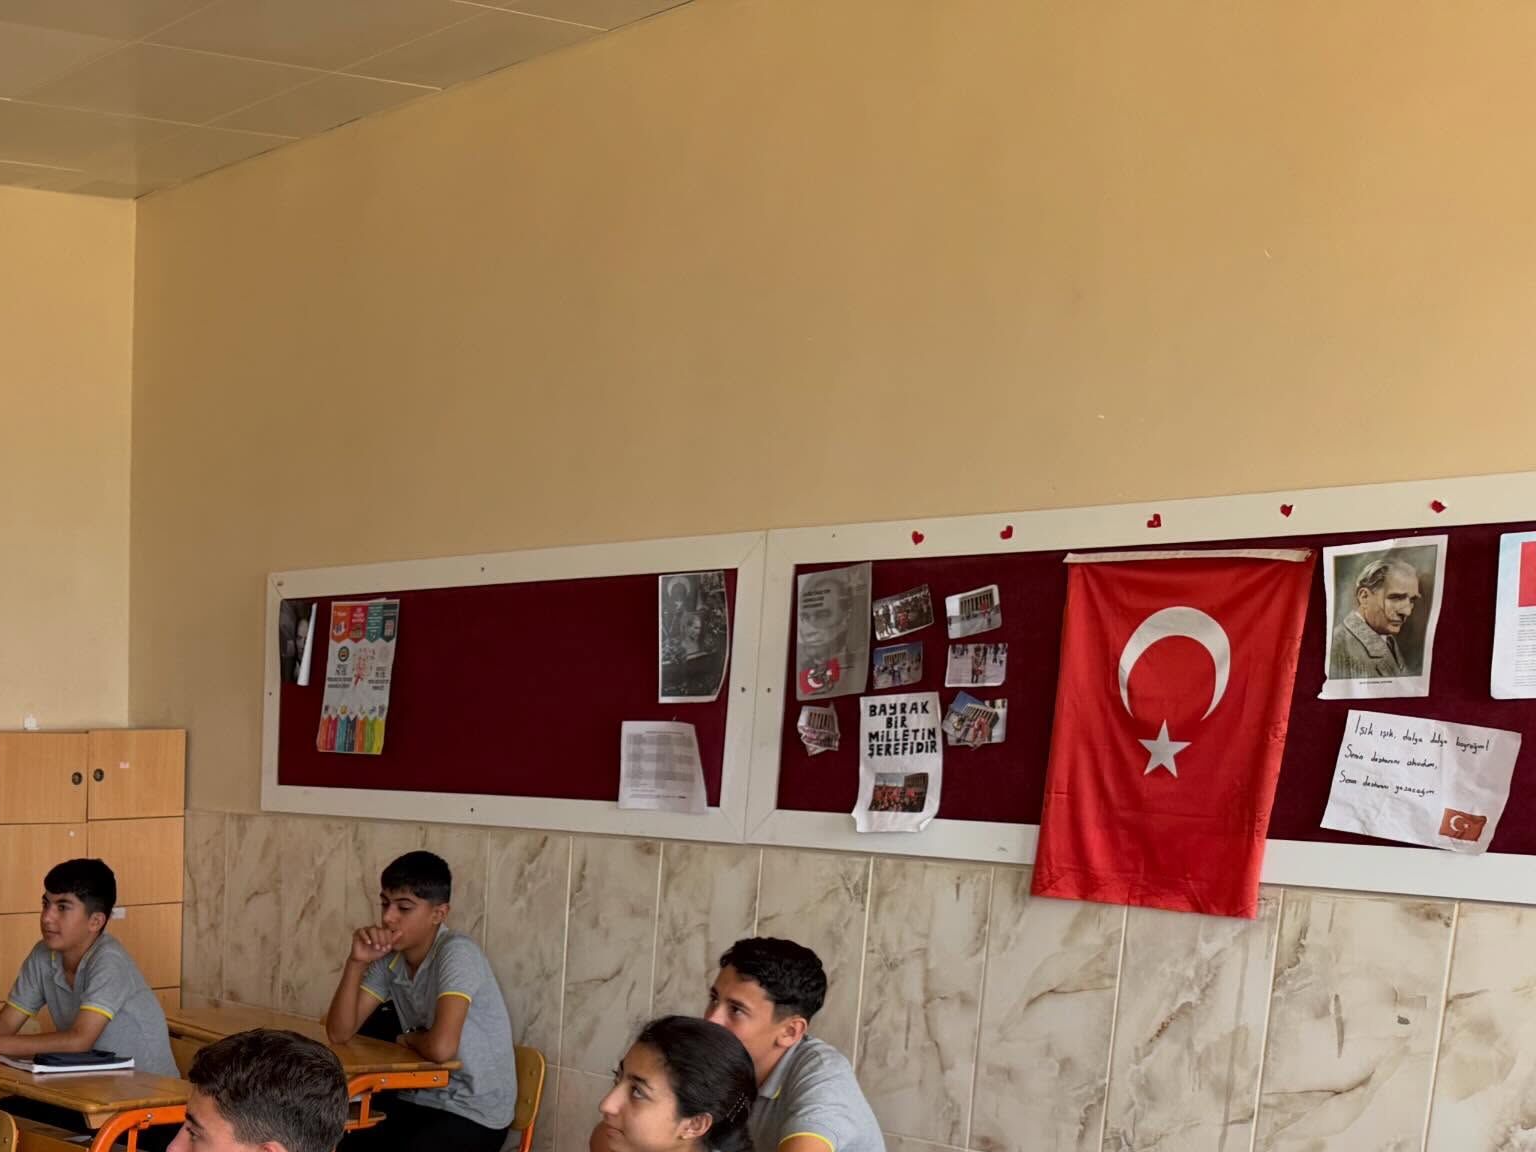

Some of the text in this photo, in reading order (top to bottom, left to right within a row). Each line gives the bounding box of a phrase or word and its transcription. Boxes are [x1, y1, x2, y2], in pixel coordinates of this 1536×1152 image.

[869, 701, 929, 717] BAYRAK
[886, 716, 908, 729] BİR
[868, 728, 937, 742] MİLLETİN
[1403, 729, 1423, 745] dalga
[1344, 744, 1364, 760] Senin
